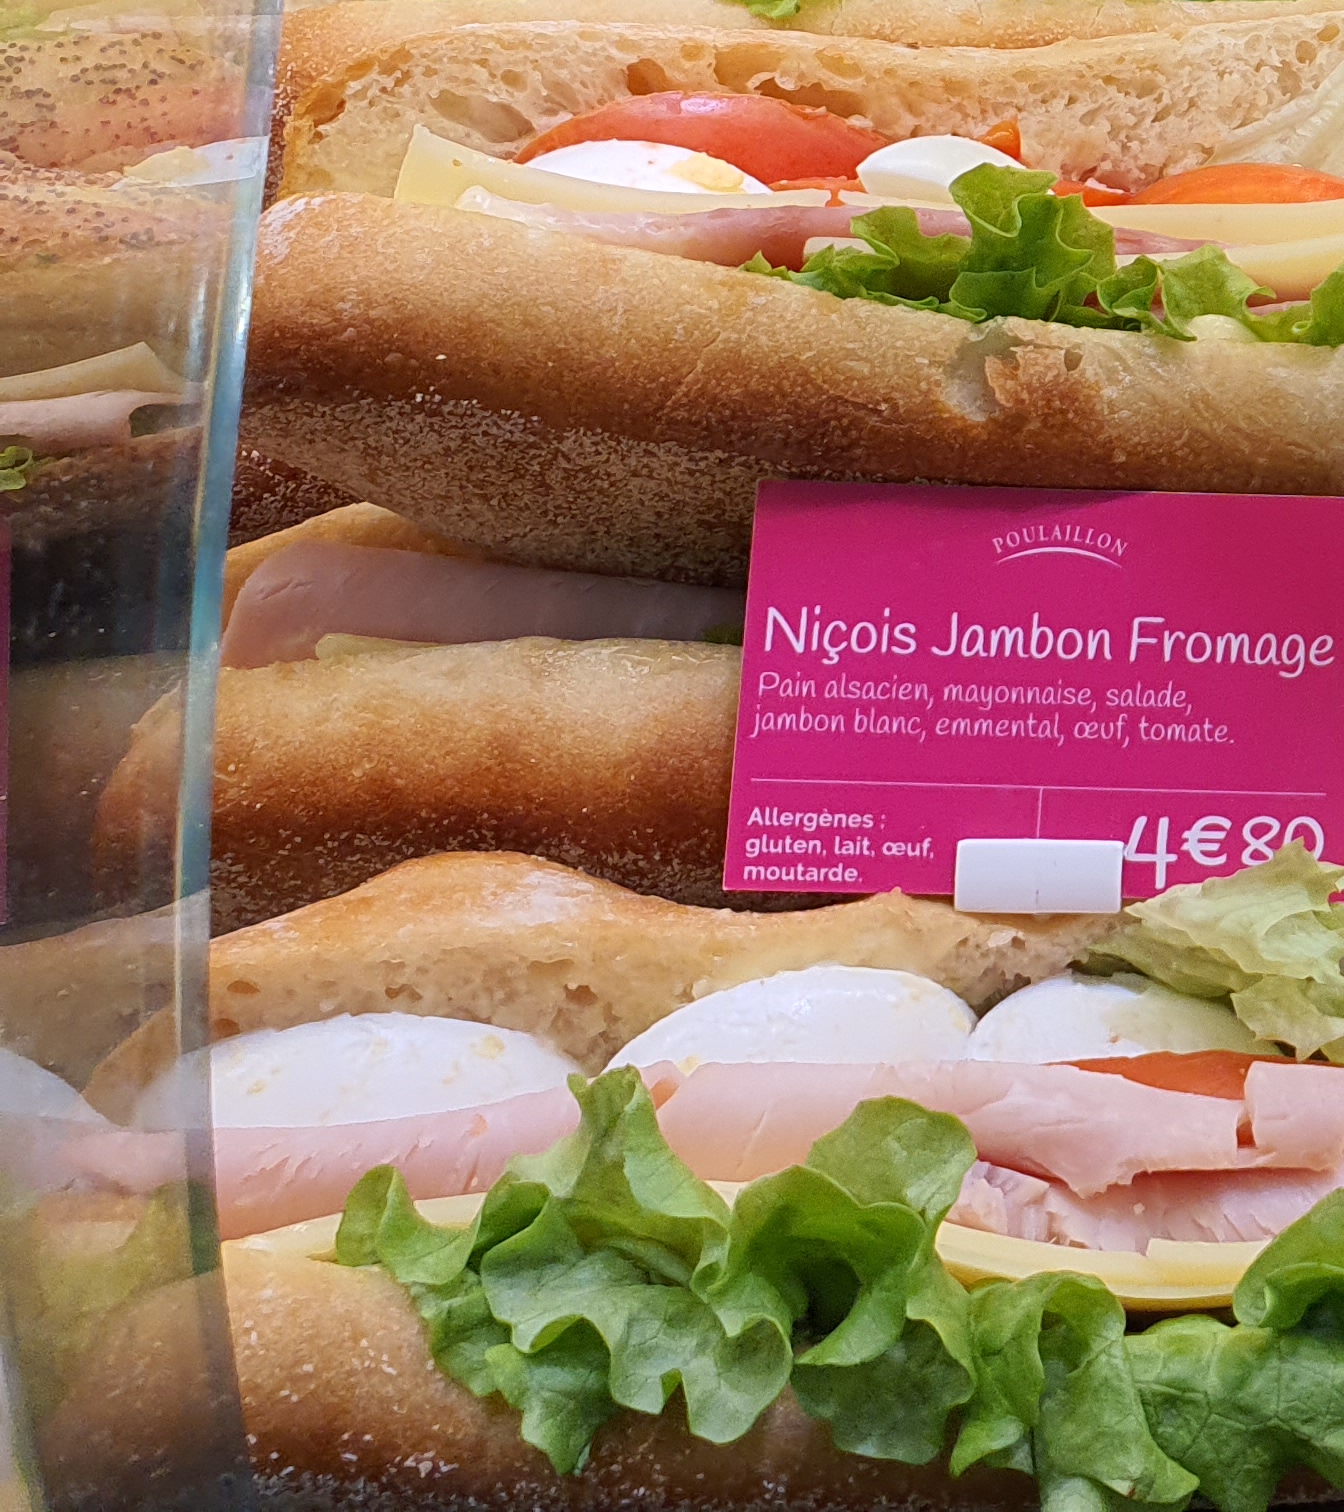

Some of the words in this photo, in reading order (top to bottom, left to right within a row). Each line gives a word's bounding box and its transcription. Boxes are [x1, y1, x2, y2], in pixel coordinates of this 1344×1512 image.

[992, 524, 1129, 557] POULAILLON
[764, 604, 917, 665] Niçois
[931, 612, 1112, 659] Jambon
[1129, 616, 1336, 679] Fromage
[757, 671, 817, 698] Pain
[824, 673, 934, 710] alsacien,
[943, 679, 1097, 713] mayonnaise,
[1105, 680, 1192, 715] salade,
[750, 704, 845, 738] jambon
[854, 707, 927, 743] blanc,
[935, 712, 1065, 747] emmental,
[1073, 713, 1130, 748] œuf,
[1138, 716, 1235, 744] tomate.
[747, 806, 874, 832] Allergènes
[745, 834, 827, 858] gluten,
[834, 836, 876, 857] lait,
[882, 838, 934, 859] œuf,
[743, 863, 863, 884] moutarde.
